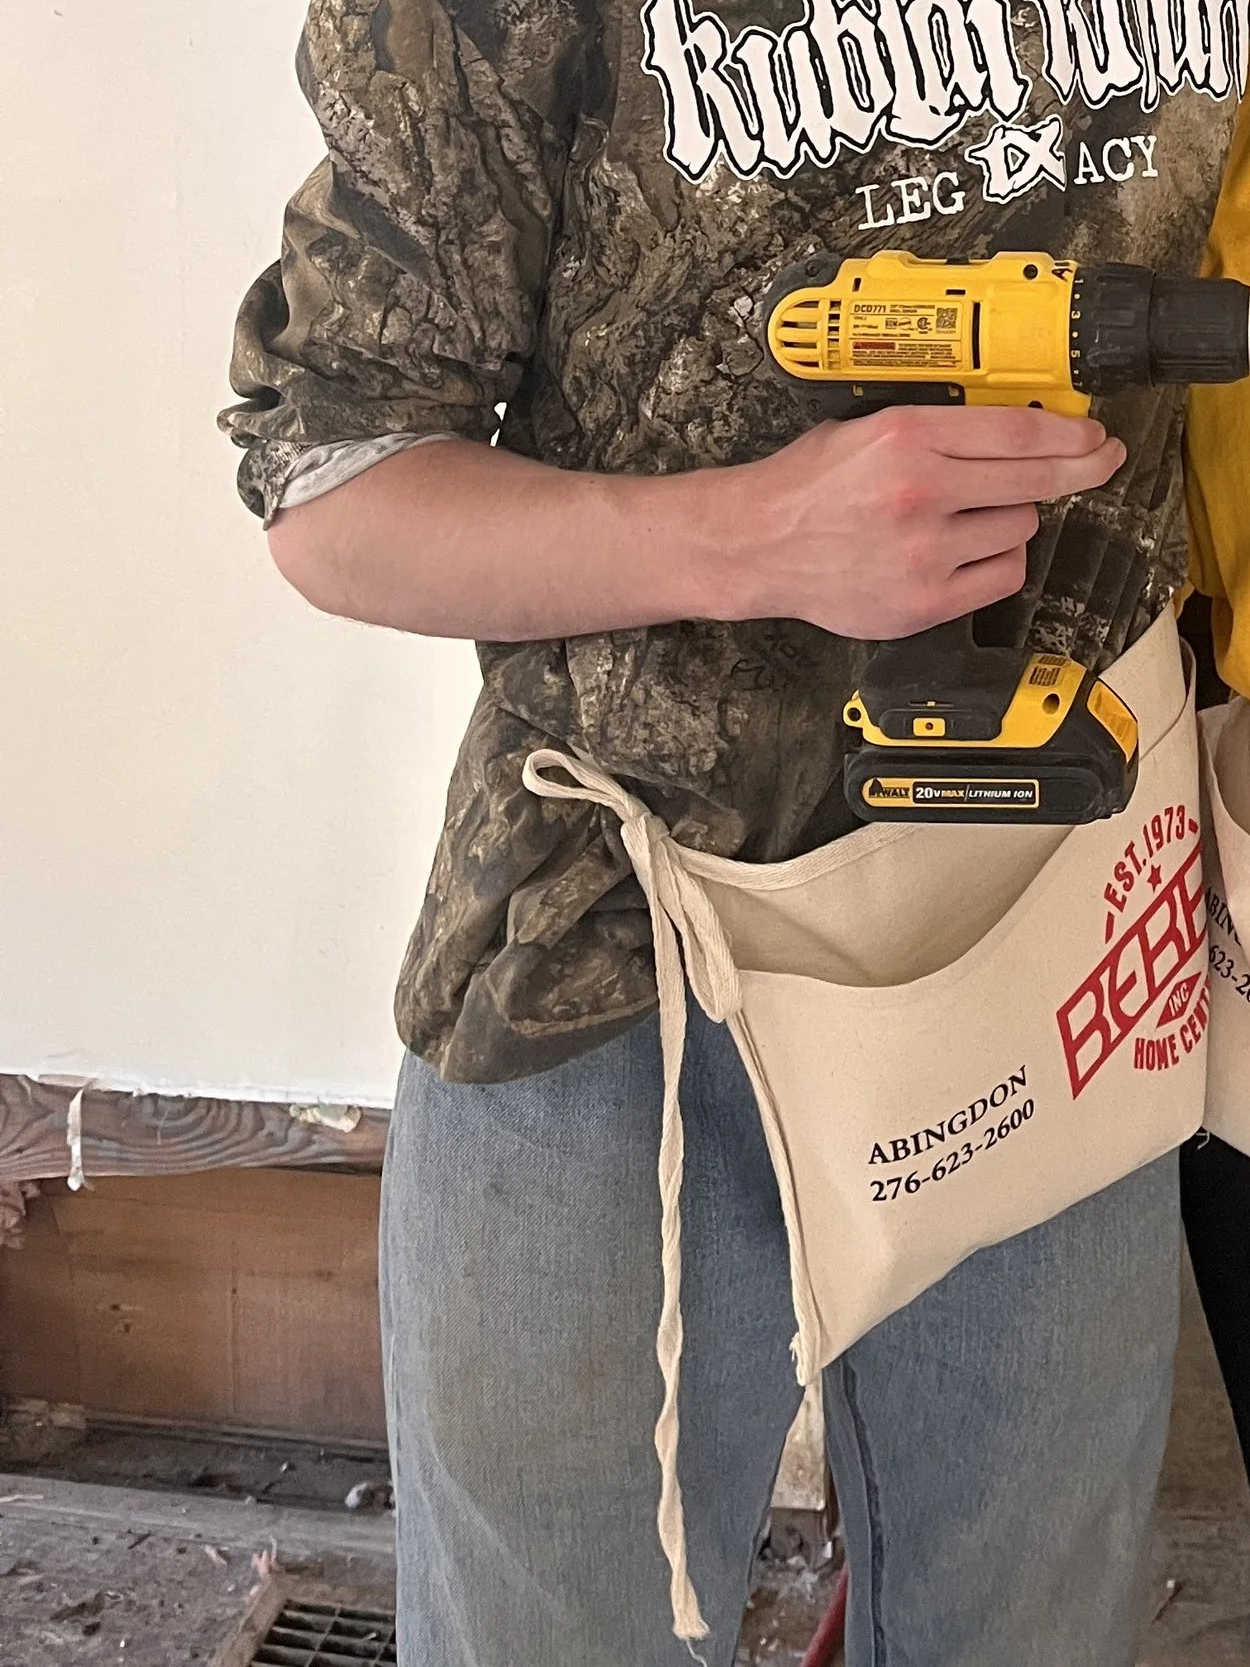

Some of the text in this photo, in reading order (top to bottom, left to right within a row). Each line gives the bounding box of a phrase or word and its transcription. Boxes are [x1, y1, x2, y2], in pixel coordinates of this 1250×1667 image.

[854, 304, 887, 313] DCD771
[968, 790, 1012, 799] LITHIUM
[1013, 790, 1033, 799] ION
[1166, 982, 1190, 1018] INC
[1133, 1036, 1180, 1072] HOME
[868, 1064, 1027, 1165] ABINGDON
[870, 1098, 1035, 1202] 276-623-2600
